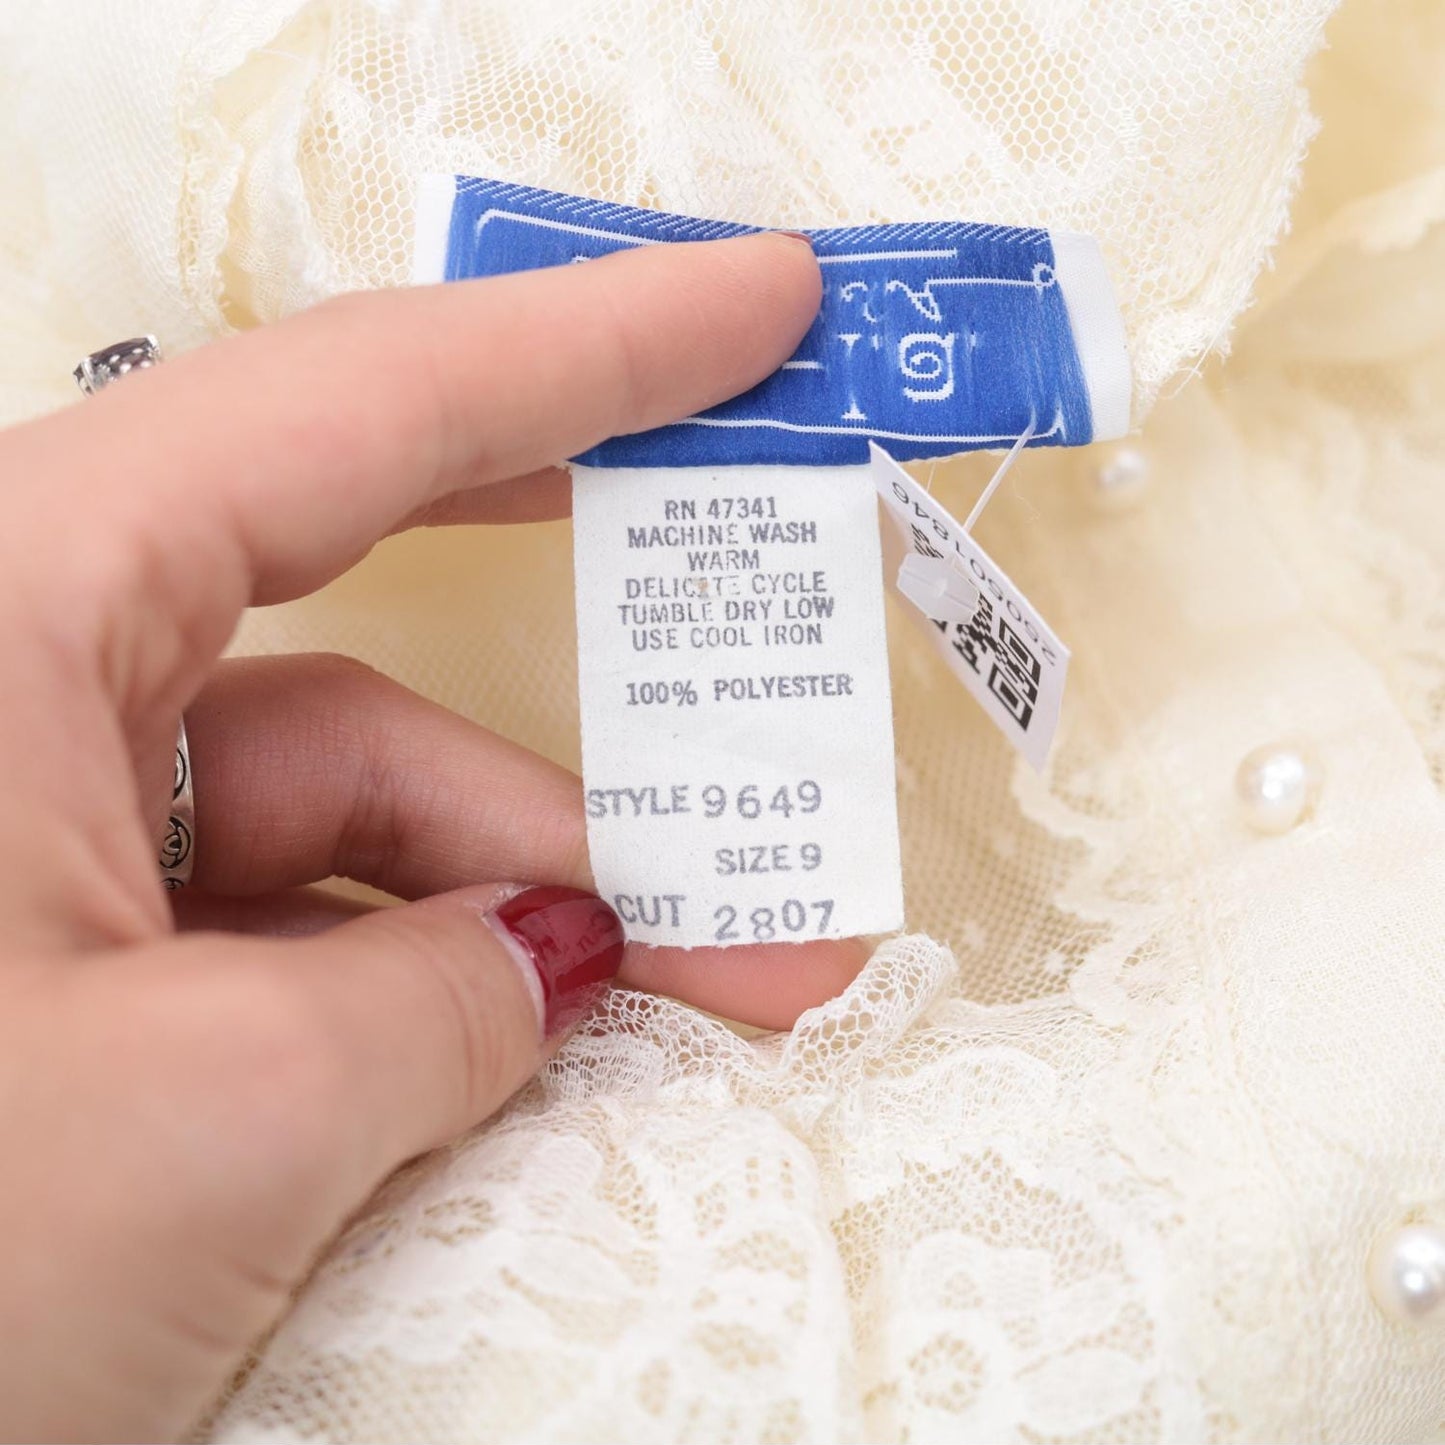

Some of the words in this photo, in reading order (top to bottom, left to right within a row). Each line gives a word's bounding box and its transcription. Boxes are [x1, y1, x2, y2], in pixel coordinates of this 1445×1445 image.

[664, 499, 696, 521] RN
[706, 496, 778, 519] 47341
[627, 523, 739, 549] MACHINE
[748, 520, 817, 545] WASH
[687, 549, 760, 572] WARM
[892, 481, 1058, 666] 250501846
[751, 571, 827, 595] CYCLE
[616, 601, 714, 626] TUMBLE
[724, 599, 772, 622] DRY
[783, 596, 834, 619] LOW
[631, 627, 678, 652] USE
[690, 625, 752, 649] COOL
[764, 623, 823, 646] IRON
[625, 680, 698, 706] 100%
[713, 673, 854, 702] POLYESTER
[586, 784, 692, 818] STYLE
[701, 780, 822, 819] 9649
[714, 844, 793, 876] SIZE
[799, 842, 823, 871] 9
[613, 893, 687, 928] CUT
[712, 899, 836, 941] 2807
